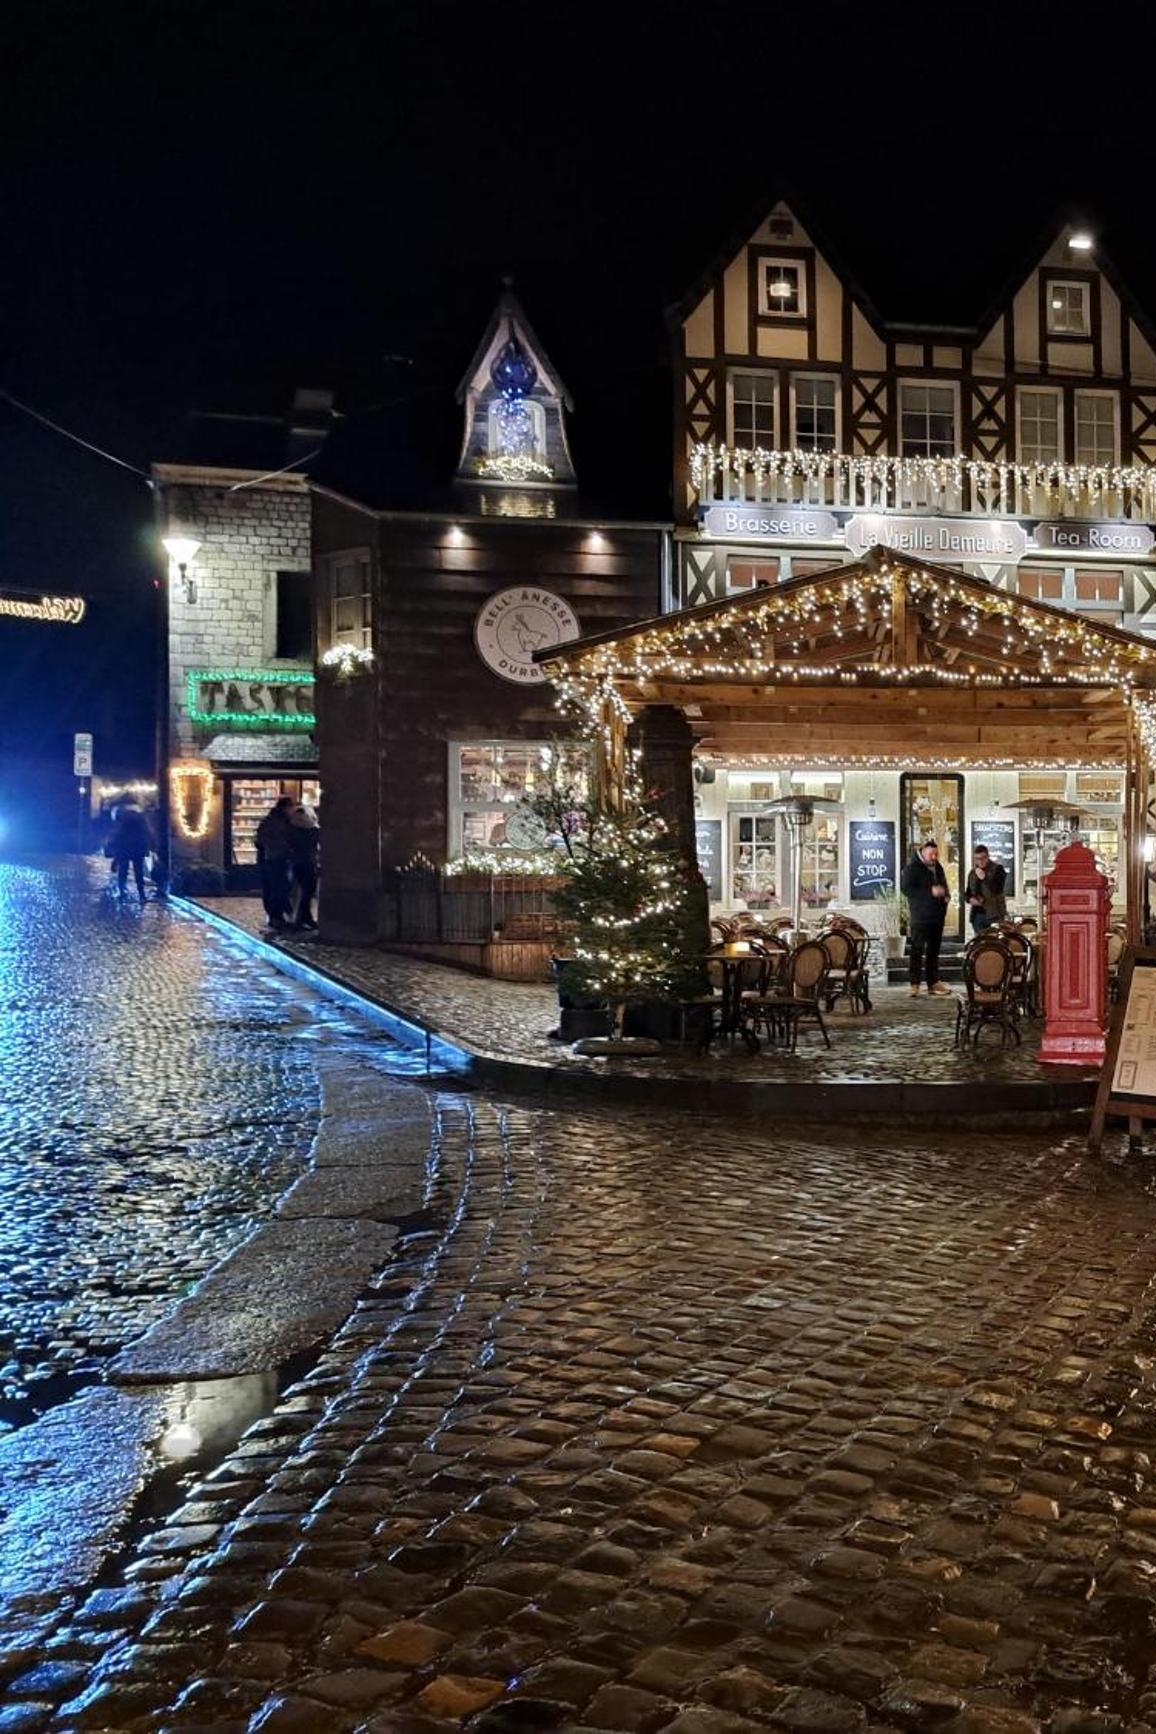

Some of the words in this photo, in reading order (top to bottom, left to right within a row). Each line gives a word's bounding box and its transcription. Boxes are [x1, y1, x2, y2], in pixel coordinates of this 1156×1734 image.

[724, 511, 817, 534] Brasserie
[859, 522, 877, 547] La
[885, 527, 933, 551] Vieille
[939, 528, 1014, 554] Demeure
[498, 659, 540, 678] DURB
[854, 829, 889, 842] Cuisine
[861, 848, 884, 860] NON
[856, 864, 888, 877] STOP
